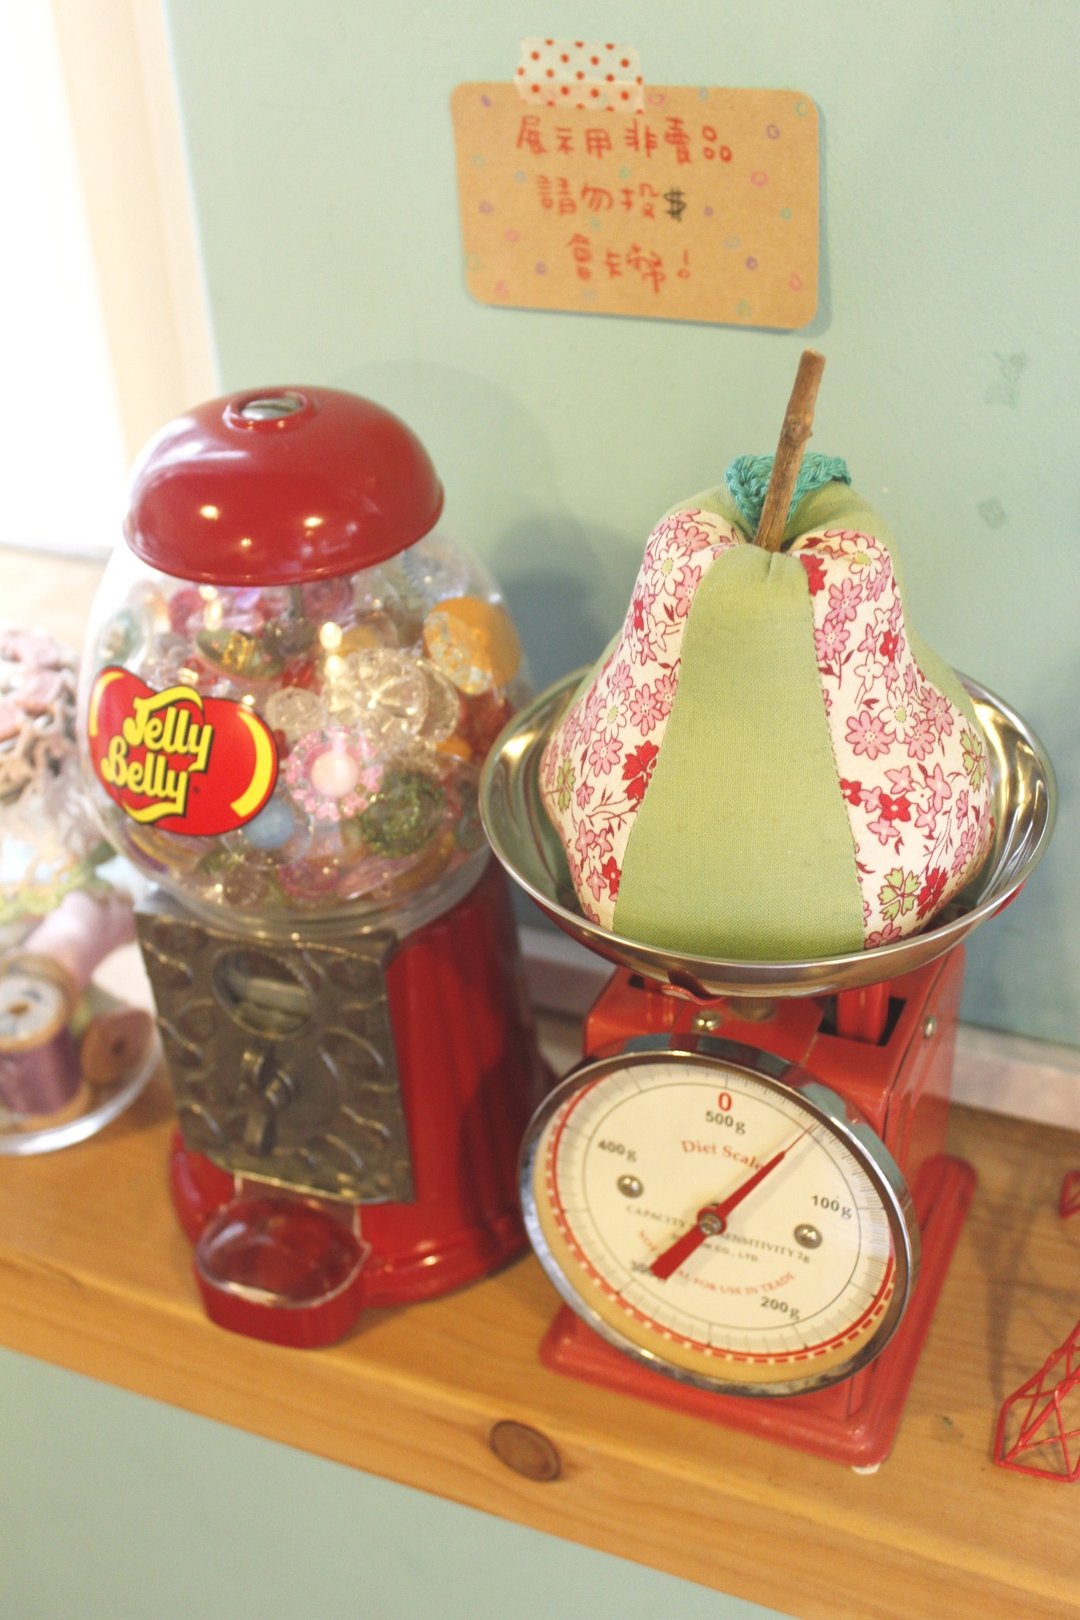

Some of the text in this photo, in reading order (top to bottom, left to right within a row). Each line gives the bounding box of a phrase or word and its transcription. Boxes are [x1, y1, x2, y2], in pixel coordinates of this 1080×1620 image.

[123, 685, 214, 773] Jelly
[101, 735, 190, 824] Belly
[718, 1092, 732, 1112] 0
[681, 1140, 718, 1154] Diet
